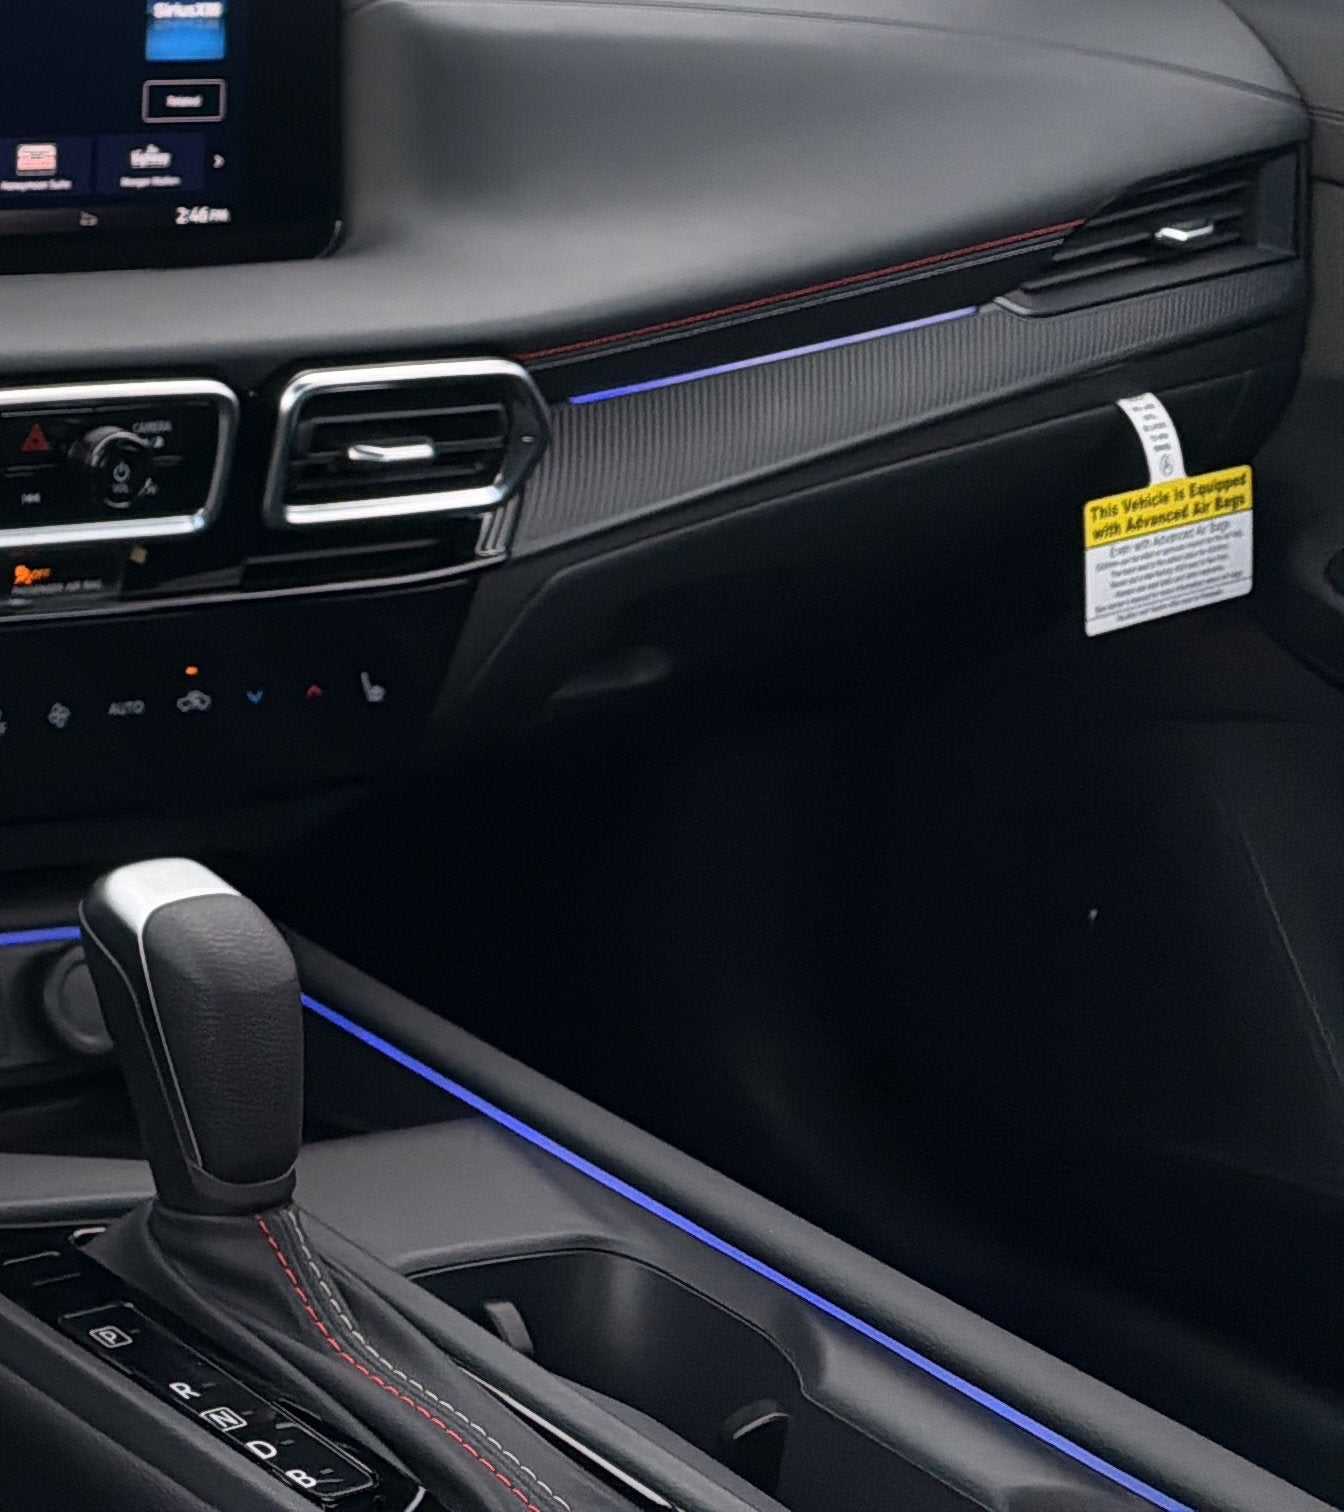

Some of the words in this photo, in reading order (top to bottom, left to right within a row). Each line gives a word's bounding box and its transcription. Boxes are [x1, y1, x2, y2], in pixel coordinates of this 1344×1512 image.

[1090, 503, 1120, 521] This
[1121, 489, 1171, 514] Vehicle
[1189, 472, 1247, 498] Equipped
[1093, 522, 1122, 539] with
[1126, 507, 1190, 533] Advanced
[1194, 500, 1211, 515] Air
[1215, 494, 1246, 512] Bags
[98, 1328, 119, 1345] P
[169, 1381, 201, 1400] R
[208, 1410, 240, 1429] N
[245, 1440, 278, 1460] D
[284, 1469, 317, 1489] B
